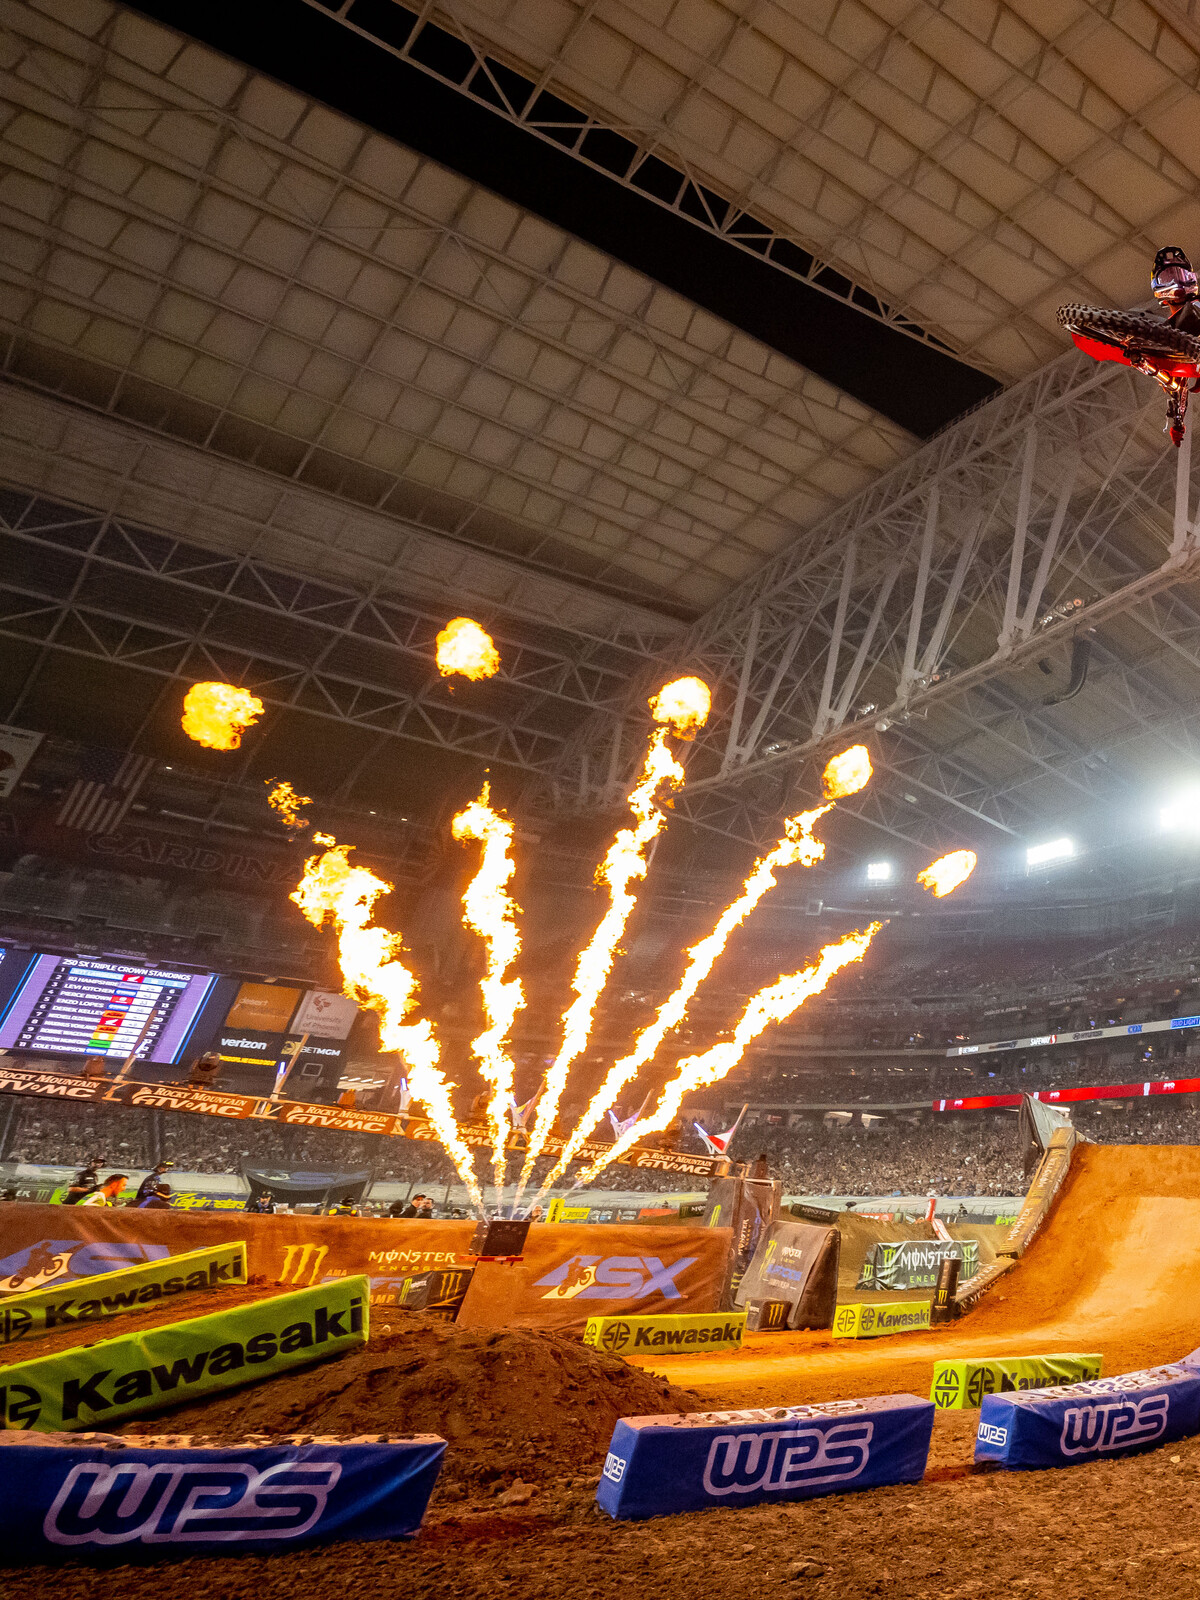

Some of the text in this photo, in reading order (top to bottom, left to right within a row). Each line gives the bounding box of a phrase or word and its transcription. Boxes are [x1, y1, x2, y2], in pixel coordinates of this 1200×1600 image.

[62, 958, 77, 967] 250
[90, 962, 117, 972] TRIPLE
[118, 966, 148, 976] CROWN
[149, 970, 191, 981] STANDINGS
[1128, 1024, 1142, 1034] COX
[1183, 1018, 1200, 1026] LIGHT
[221, 1038, 267, 1050] verizon
[36, 1075, 100, 1089] MOUNTAIN
[154, 1088, 248, 1106] ROCKY MOUNTAIN
[305, 1107, 389, 1122] ROCKY MOUNTAIN
[651, 1153, 713, 1167] ROCKY MOUNTAIN
[369, 1250, 456, 1264] MONSTER
[327, 1269, 347, 1277] AMA
[910, 1275, 936, 1284] ENER
[45, 1254, 242, 1328] Kawasaki
[876, 1309, 929, 1328] Kawasaki
[634, 1320, 743, 1349] Kawasaki
[61, 1298, 364, 1420] Kawasaki
[1060, 1394, 1169, 1456] WPS
[978, 1422, 1008, 1447] WPS
[603, 1452, 627, 1483] WPS
[703, 1421, 874, 1496] WPS
[43, 1462, 342, 1545] WPS
